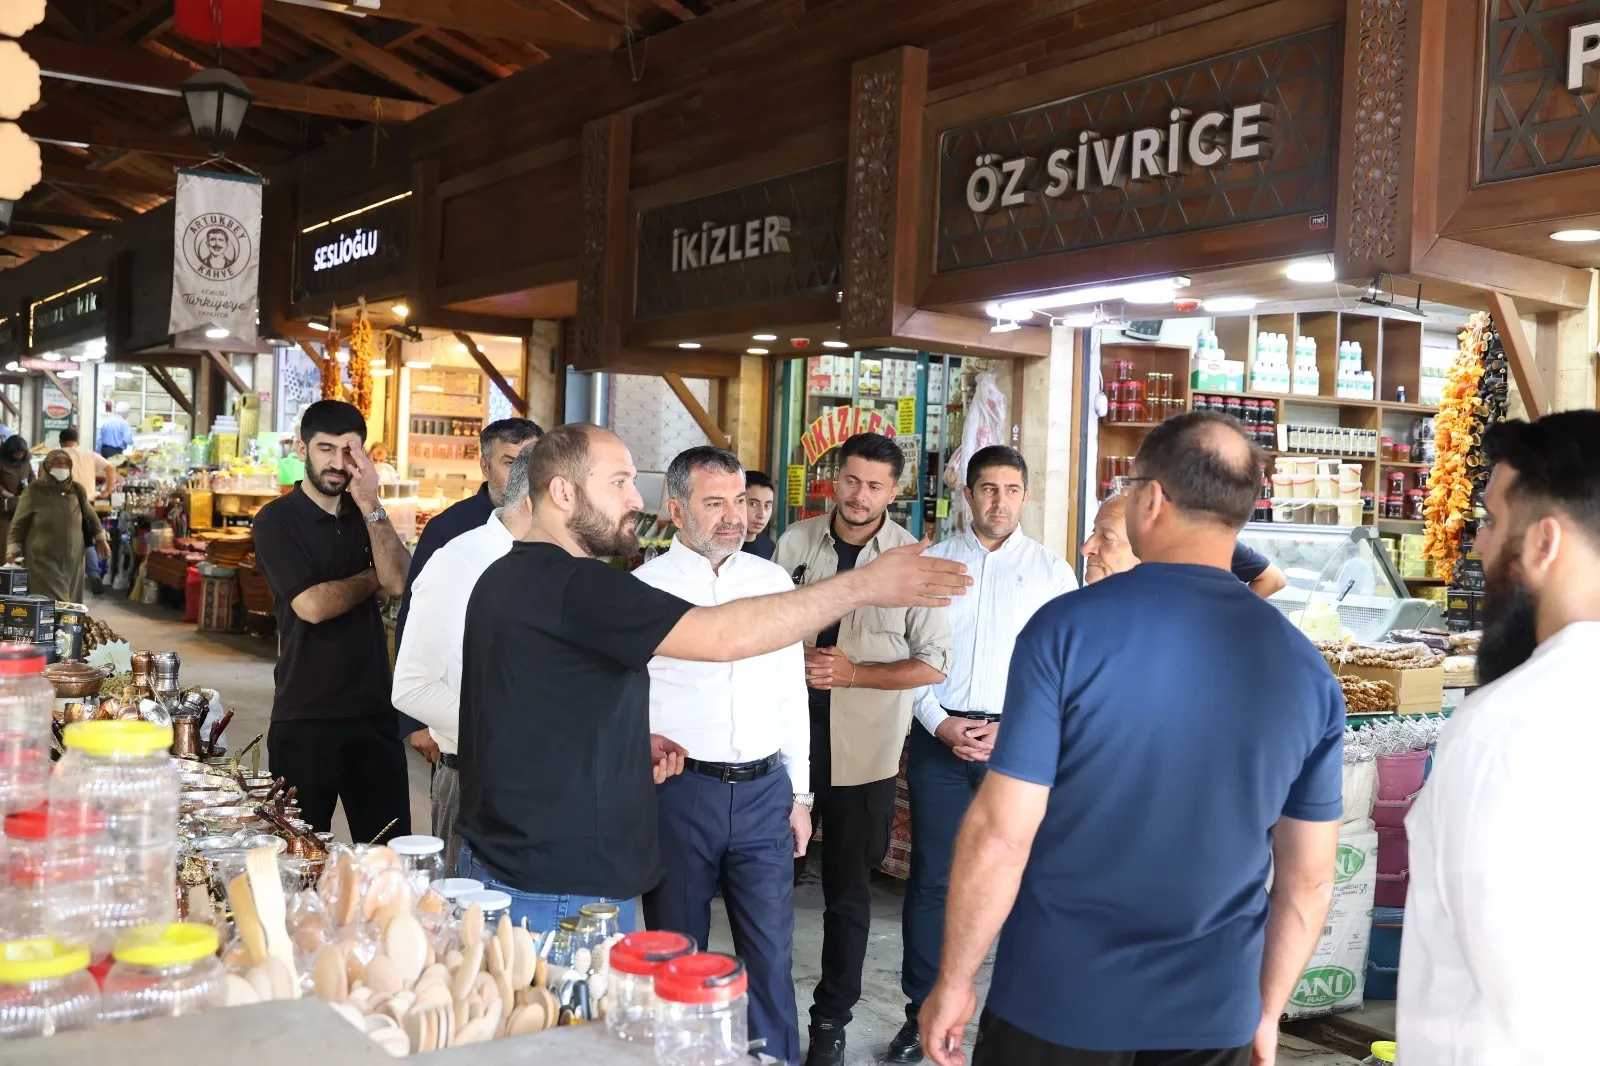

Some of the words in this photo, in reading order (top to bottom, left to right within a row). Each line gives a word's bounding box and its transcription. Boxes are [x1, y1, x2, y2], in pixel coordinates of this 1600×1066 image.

[966, 153, 1034, 213] ÖZ
[1044, 102, 1272, 197] SİVRİCE
[190, 215, 246, 239] ARTUKBEY
[313, 228, 378, 272] SESLİOĞLU
[671, 215, 788, 272] İKİZLER
[198, 264, 235, 279] KAHVE
[181, 293, 247, 313] Türkiye'ye
[1306, 995, 1327, 1003] PLAST
